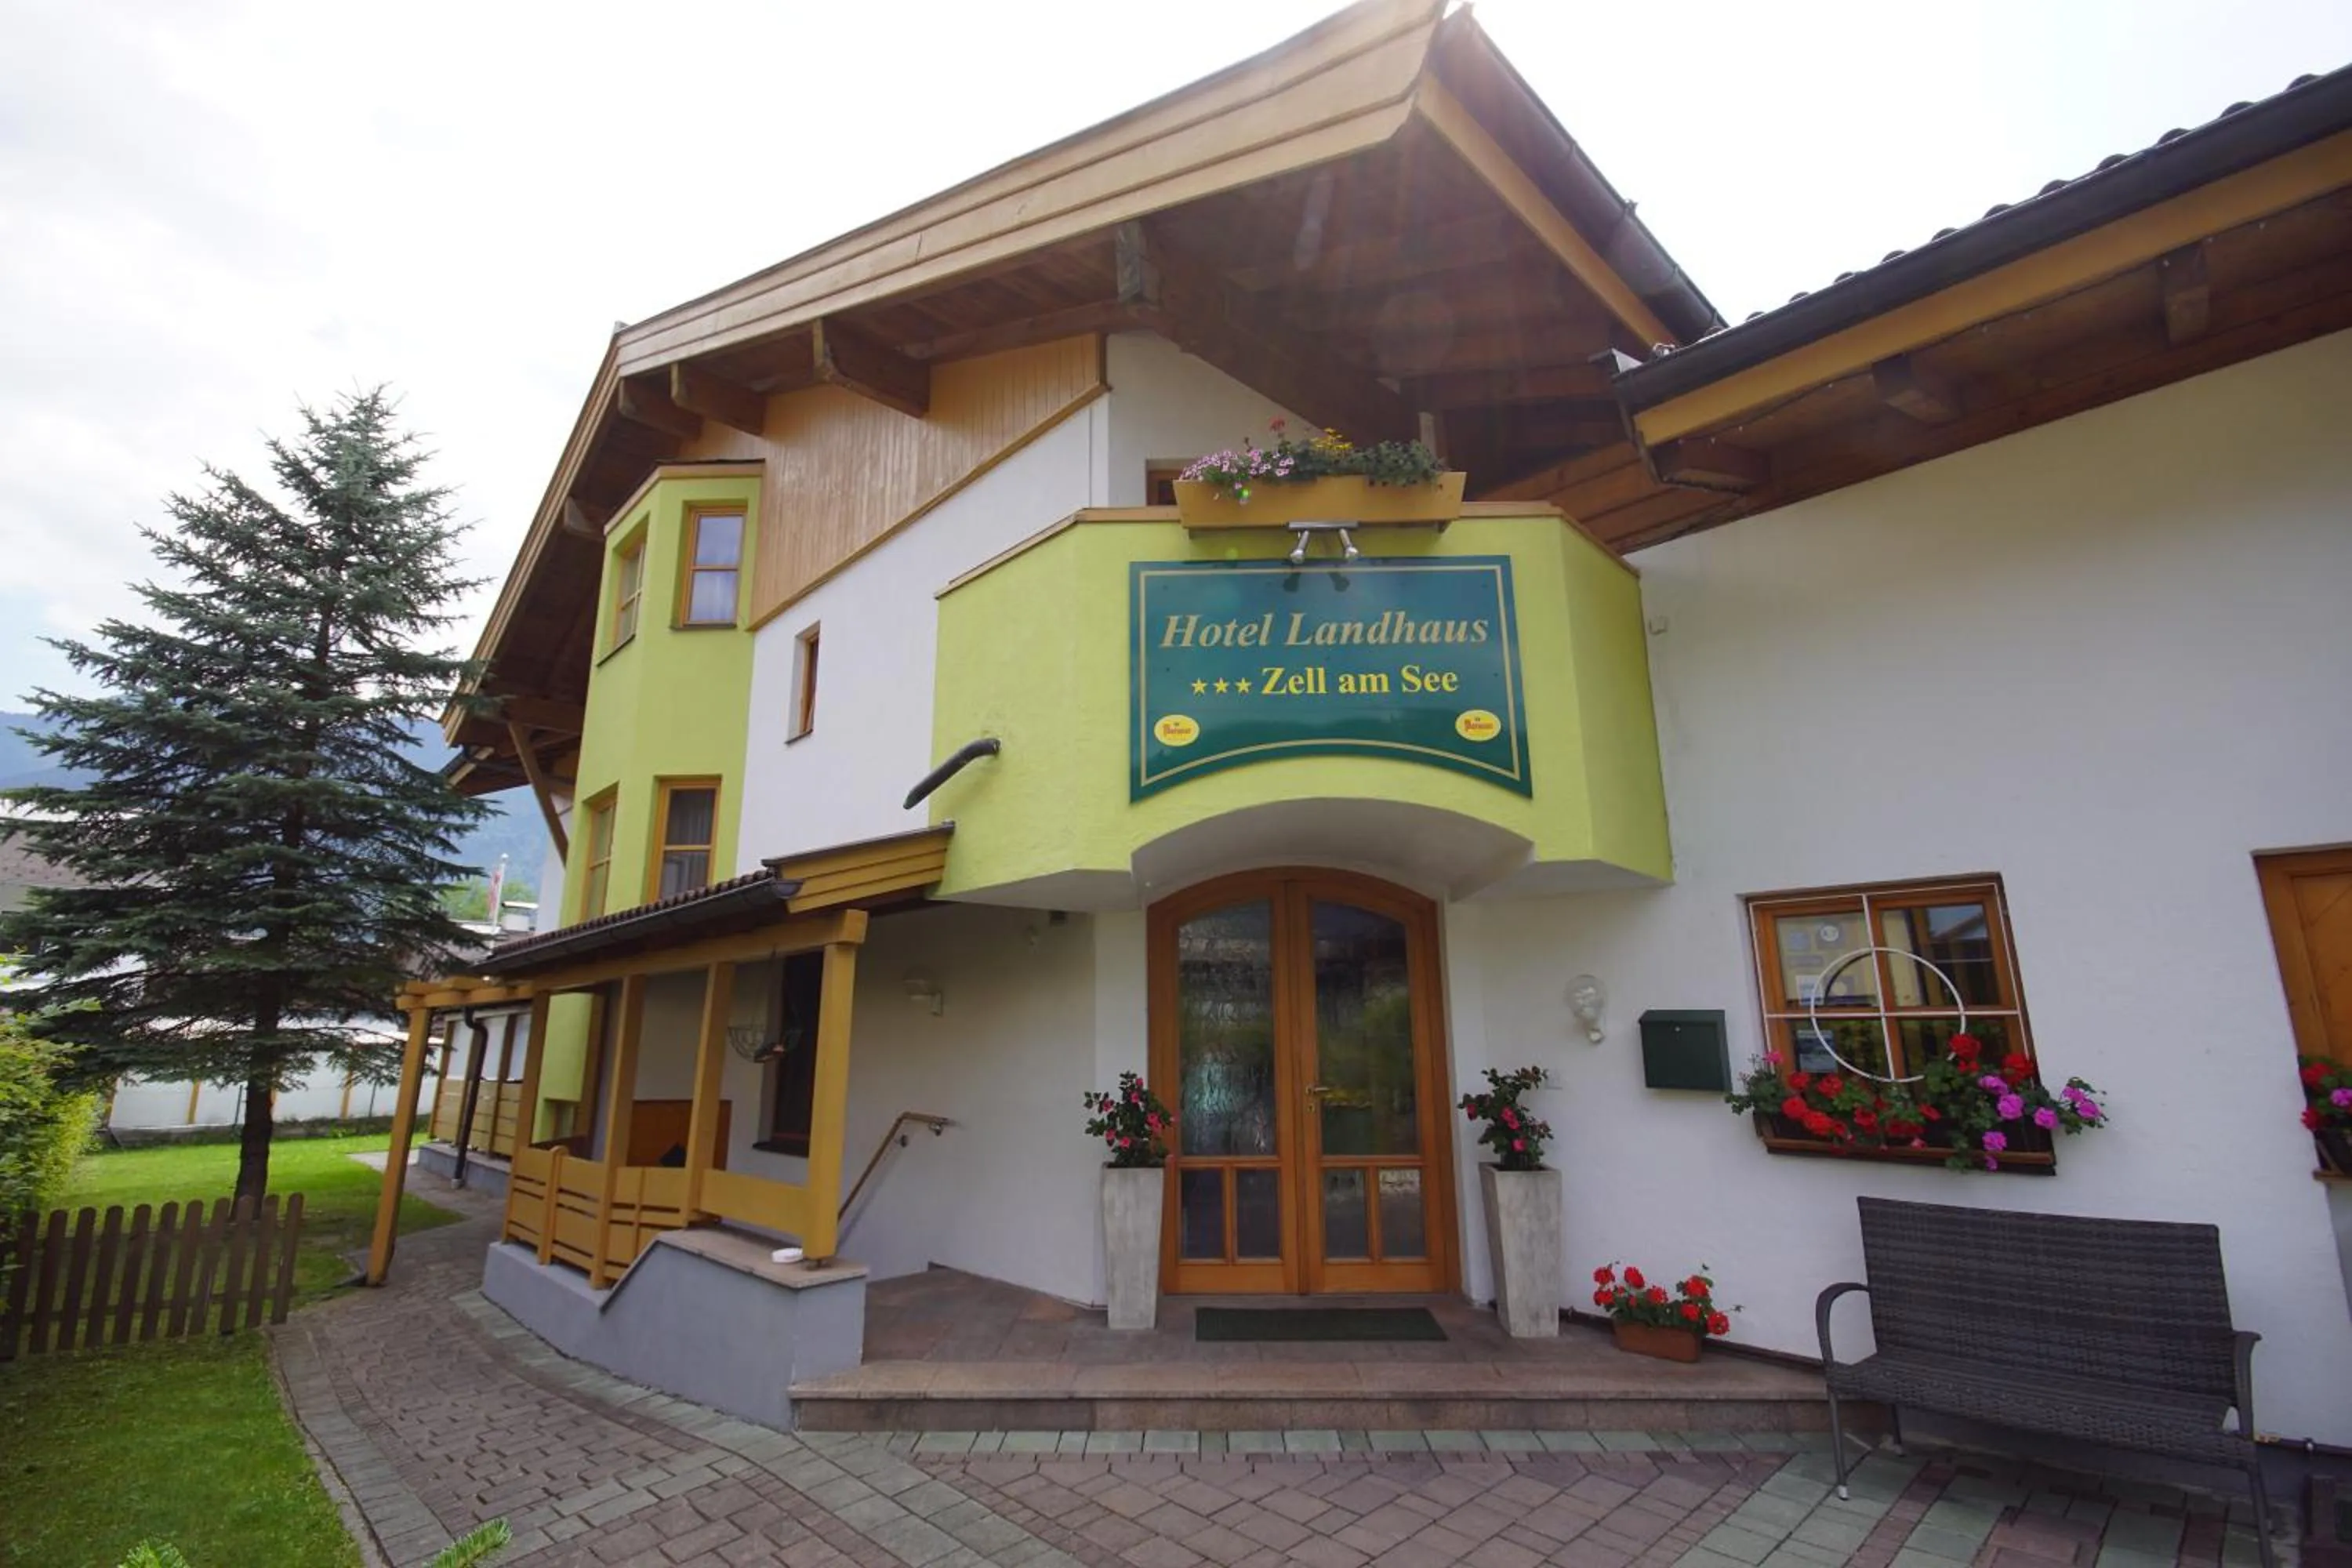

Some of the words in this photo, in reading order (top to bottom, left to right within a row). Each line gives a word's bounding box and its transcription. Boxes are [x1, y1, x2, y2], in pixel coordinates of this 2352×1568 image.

[1159, 613, 1273, 648] Hotel
[1283, 611, 1489, 647] Landhaus
[1261, 666, 1327, 696] Zell
[1338, 673, 1391, 695] am
[1400, 664, 1460, 694] See
